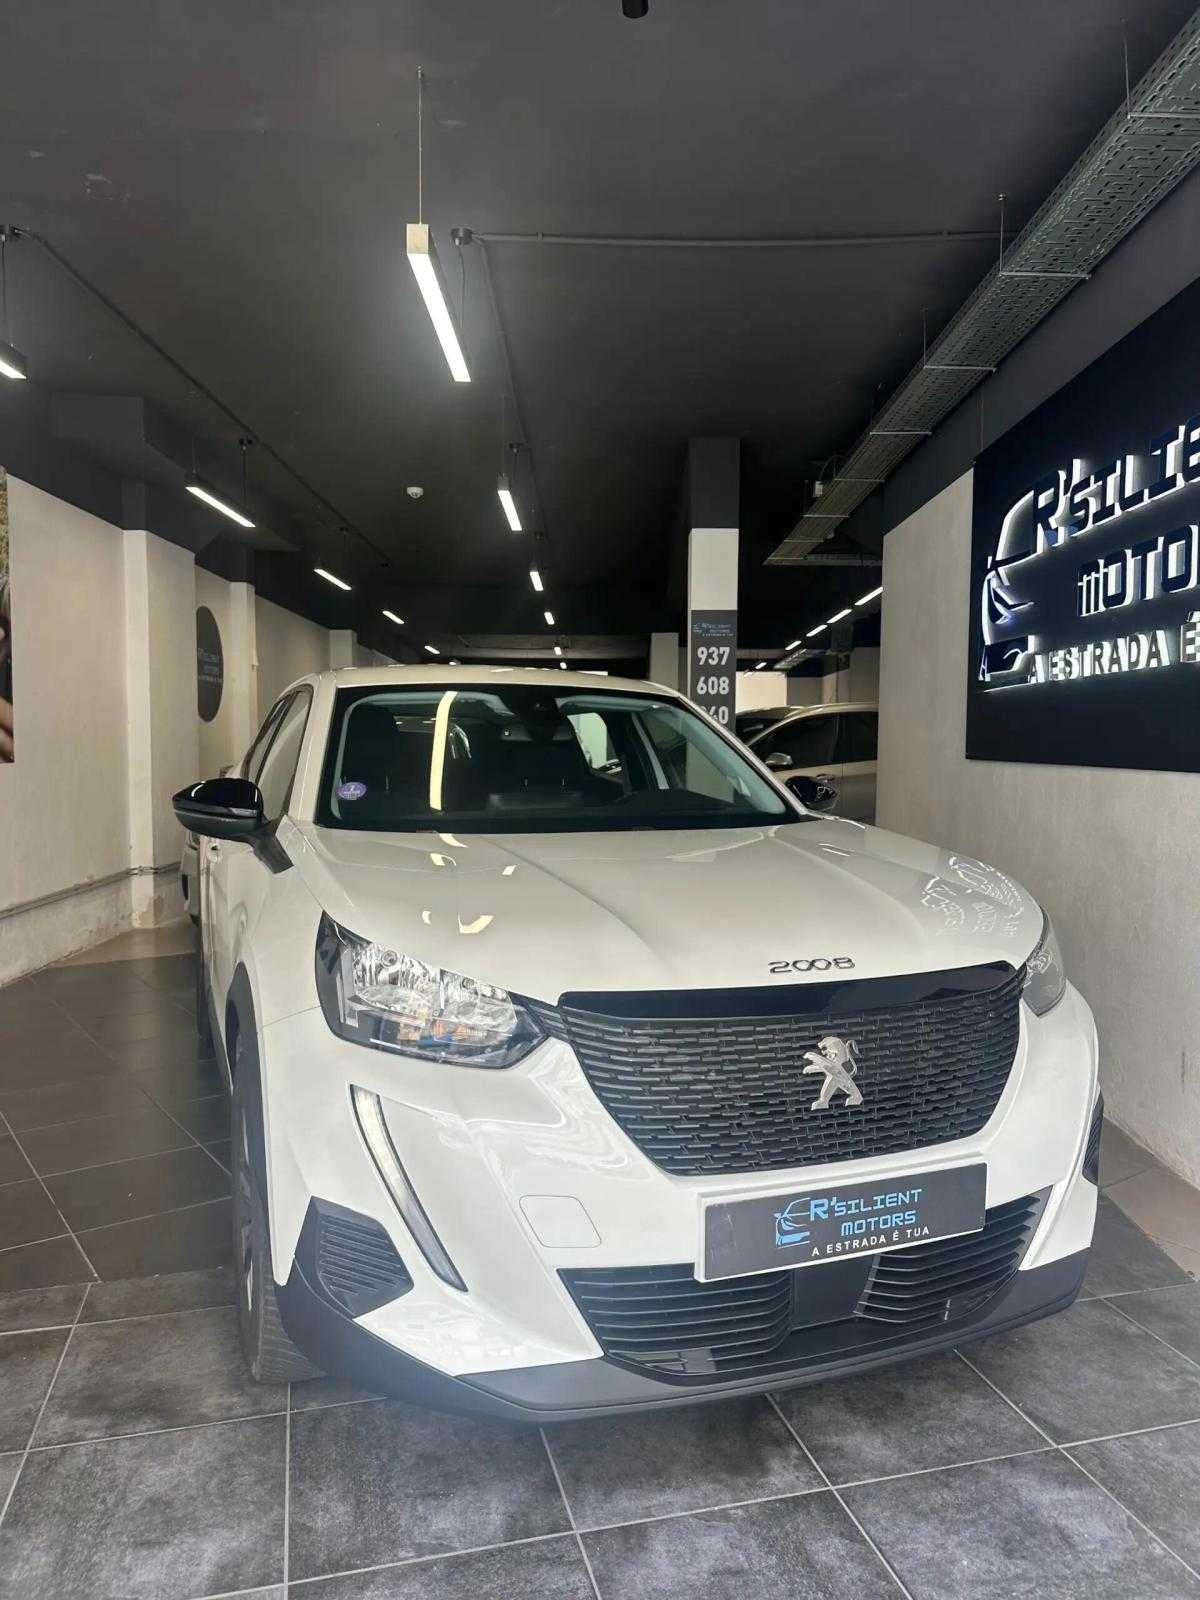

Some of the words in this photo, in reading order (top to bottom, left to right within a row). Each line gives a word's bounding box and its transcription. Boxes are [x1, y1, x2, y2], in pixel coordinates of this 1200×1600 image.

[697, 646, 730, 665] 937
[1029, 654, 1046, 684] A
[1049, 630, 1171, 681] ESTRADA
[697, 676, 729, 695] 608
[700, 705, 729, 724] 60
[768, 956, 856, 974] 2008
[810, 1188, 922, 1222] R'SILIENT
[840, 1209, 917, 1237] MOTORS
[812, 1246, 820, 1257] A
[826, 1234, 886, 1254] ESTRADA
[892, 1228, 900, 1241] É
[905, 1225, 930, 1239] TUA
